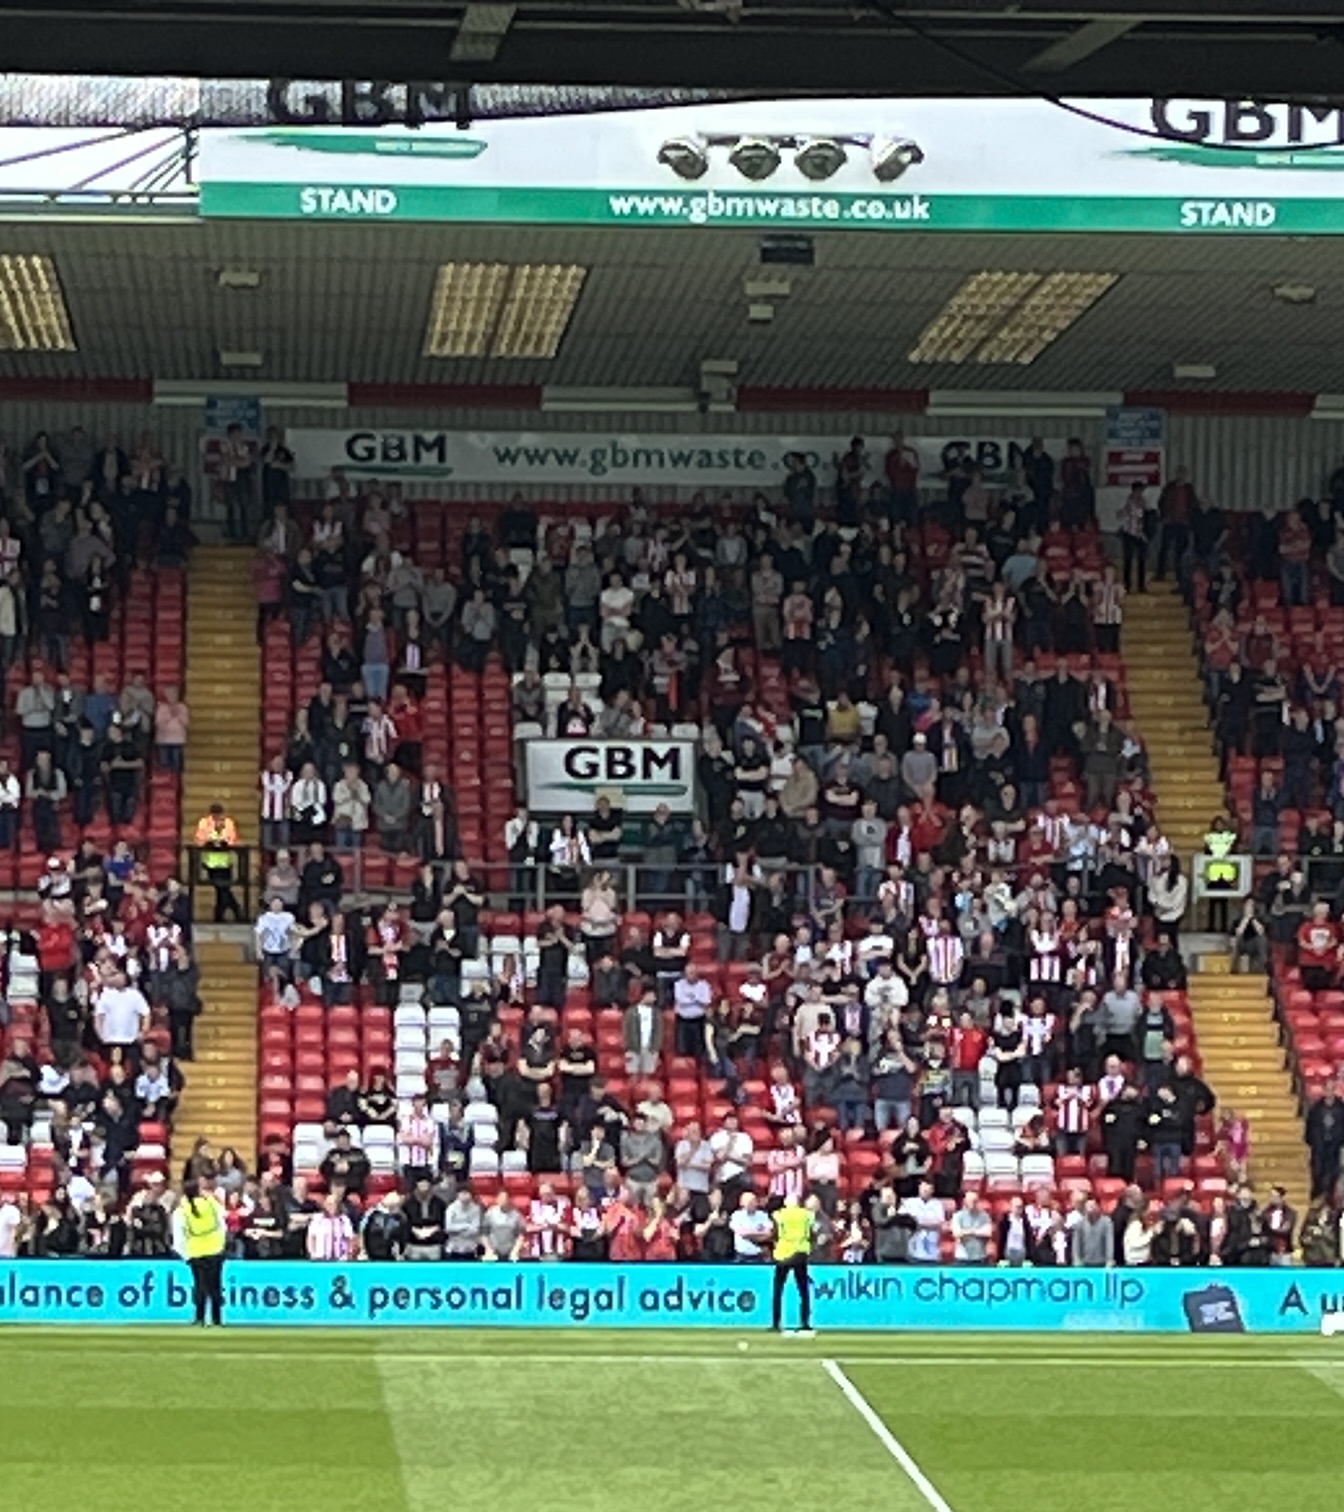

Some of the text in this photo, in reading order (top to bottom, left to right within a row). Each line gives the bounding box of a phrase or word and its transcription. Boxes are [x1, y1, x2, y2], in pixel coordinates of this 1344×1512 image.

[300, 187, 398, 214] STAND
[609, 193, 930, 225] www.gbmwaste.co.uk
[1180, 201, 1276, 227] STAND
[346, 433, 446, 463] GBM
[564, 745, 681, 780] GBM
[118, 1271, 155, 1306] of
[167, 1270, 315, 1309] biness
[328, 1276, 356, 1309] &
[369, 1274, 523, 1319] personal
[537, 1275, 625, 1320] legal
[639, 1277, 756, 1312] advice
[808, 1270, 1144, 1306] wilkin chapman llp
[1279, 1283, 1308, 1315] A
